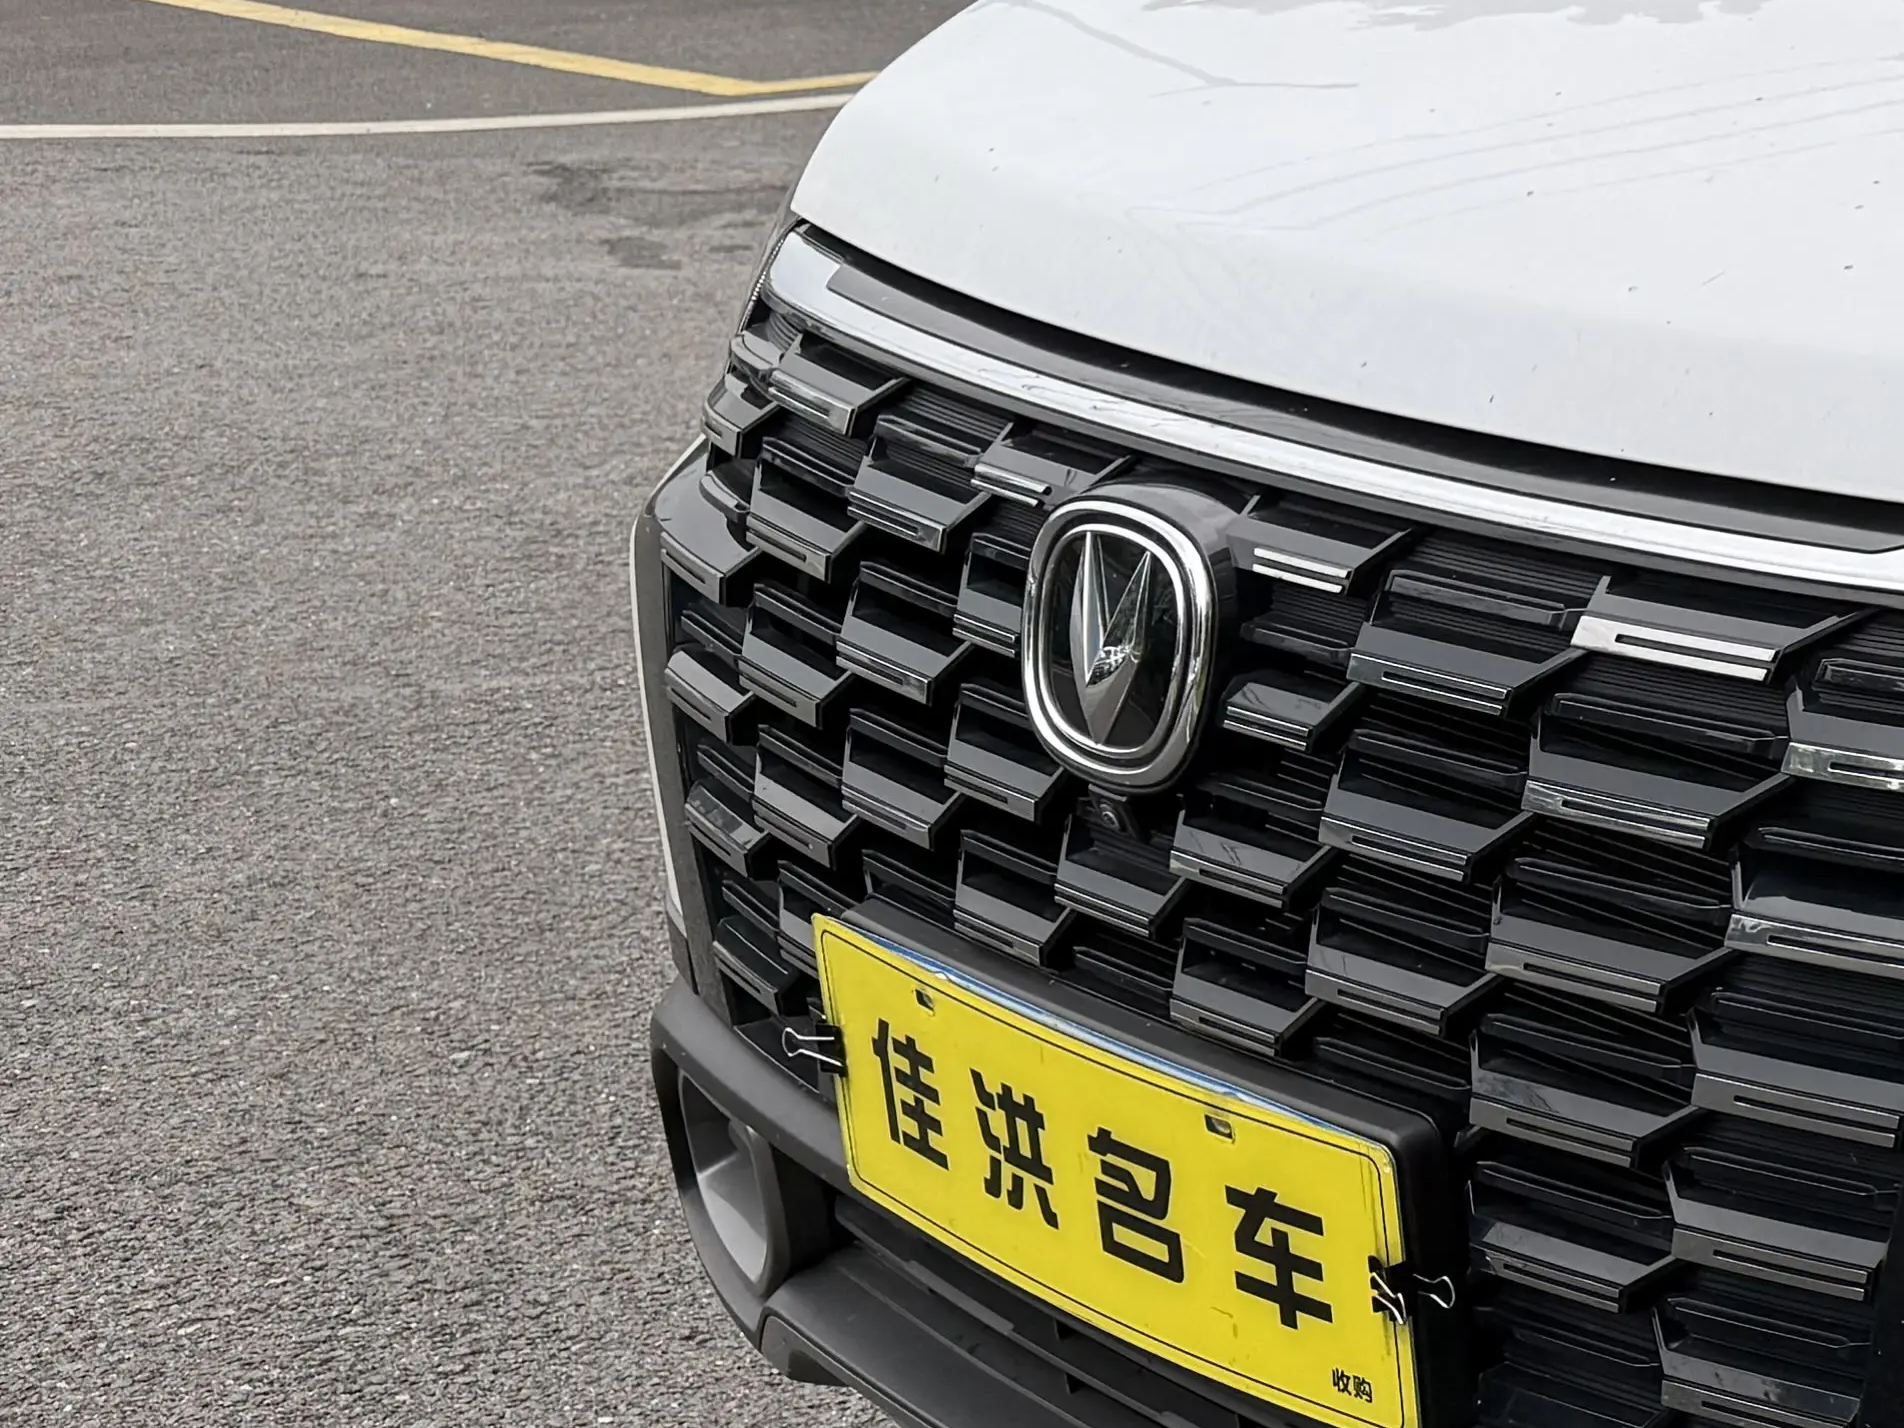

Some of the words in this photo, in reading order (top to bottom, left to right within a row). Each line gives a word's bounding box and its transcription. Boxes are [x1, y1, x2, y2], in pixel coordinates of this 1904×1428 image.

[871, 1018, 1335, 1331] 佳洪名车
[1331, 1367, 1374, 1403] 收购
